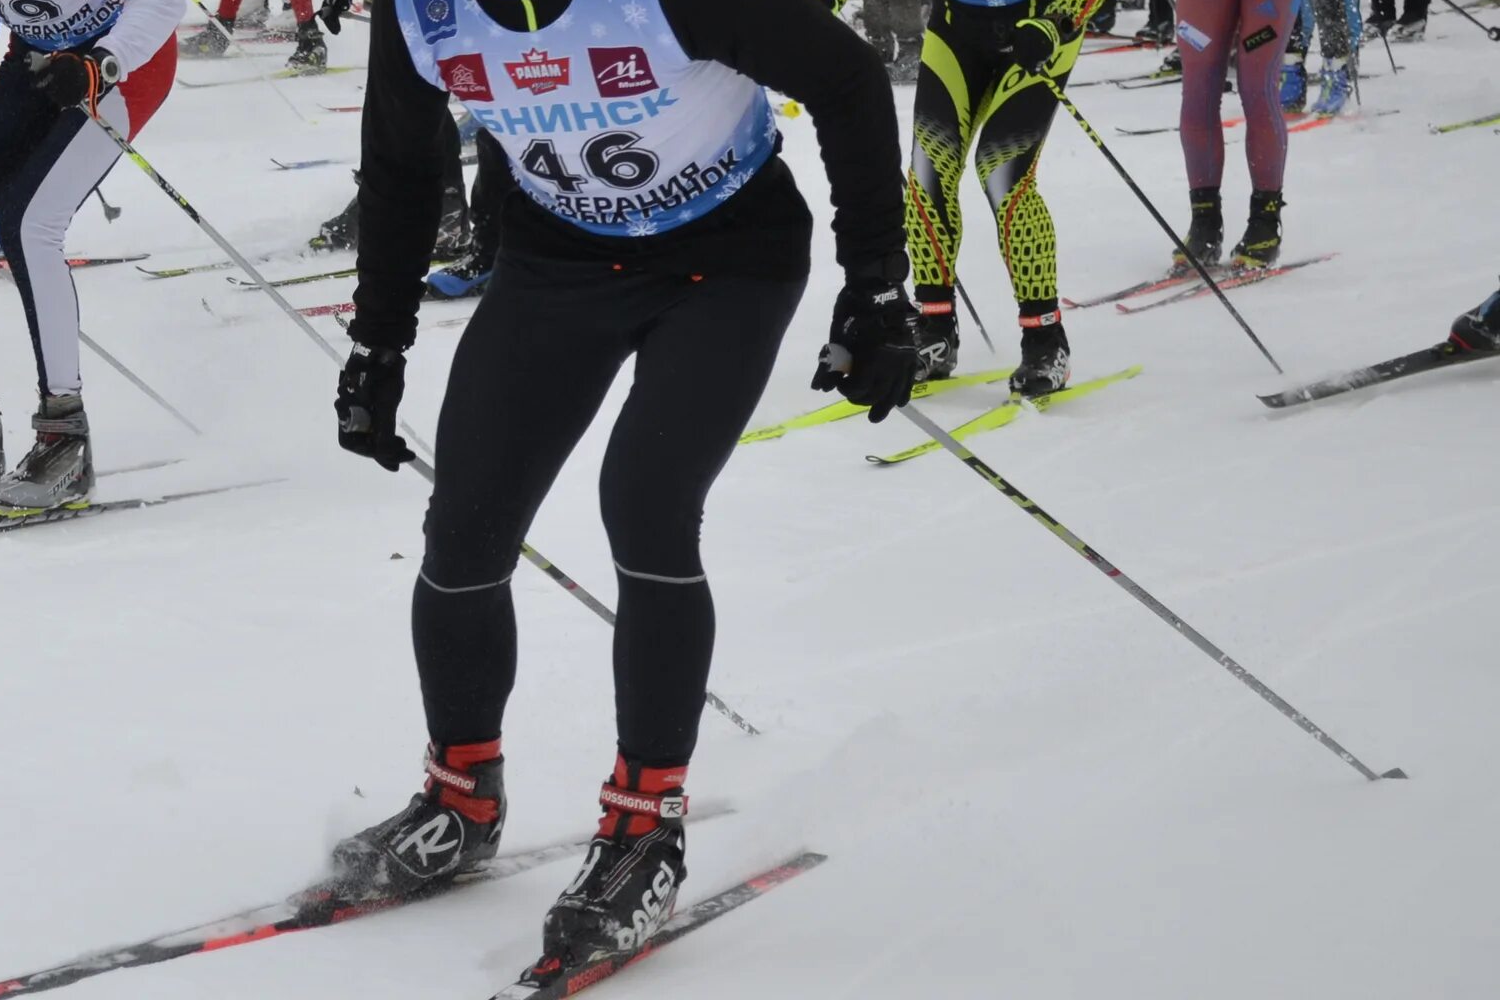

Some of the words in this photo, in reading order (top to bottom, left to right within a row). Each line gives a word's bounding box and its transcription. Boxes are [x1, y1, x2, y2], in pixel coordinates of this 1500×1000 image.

[474, 87, 679, 136] БНИНСК
[520, 130, 660, 195] 46
[616, 860, 675, 950] ROSSI
